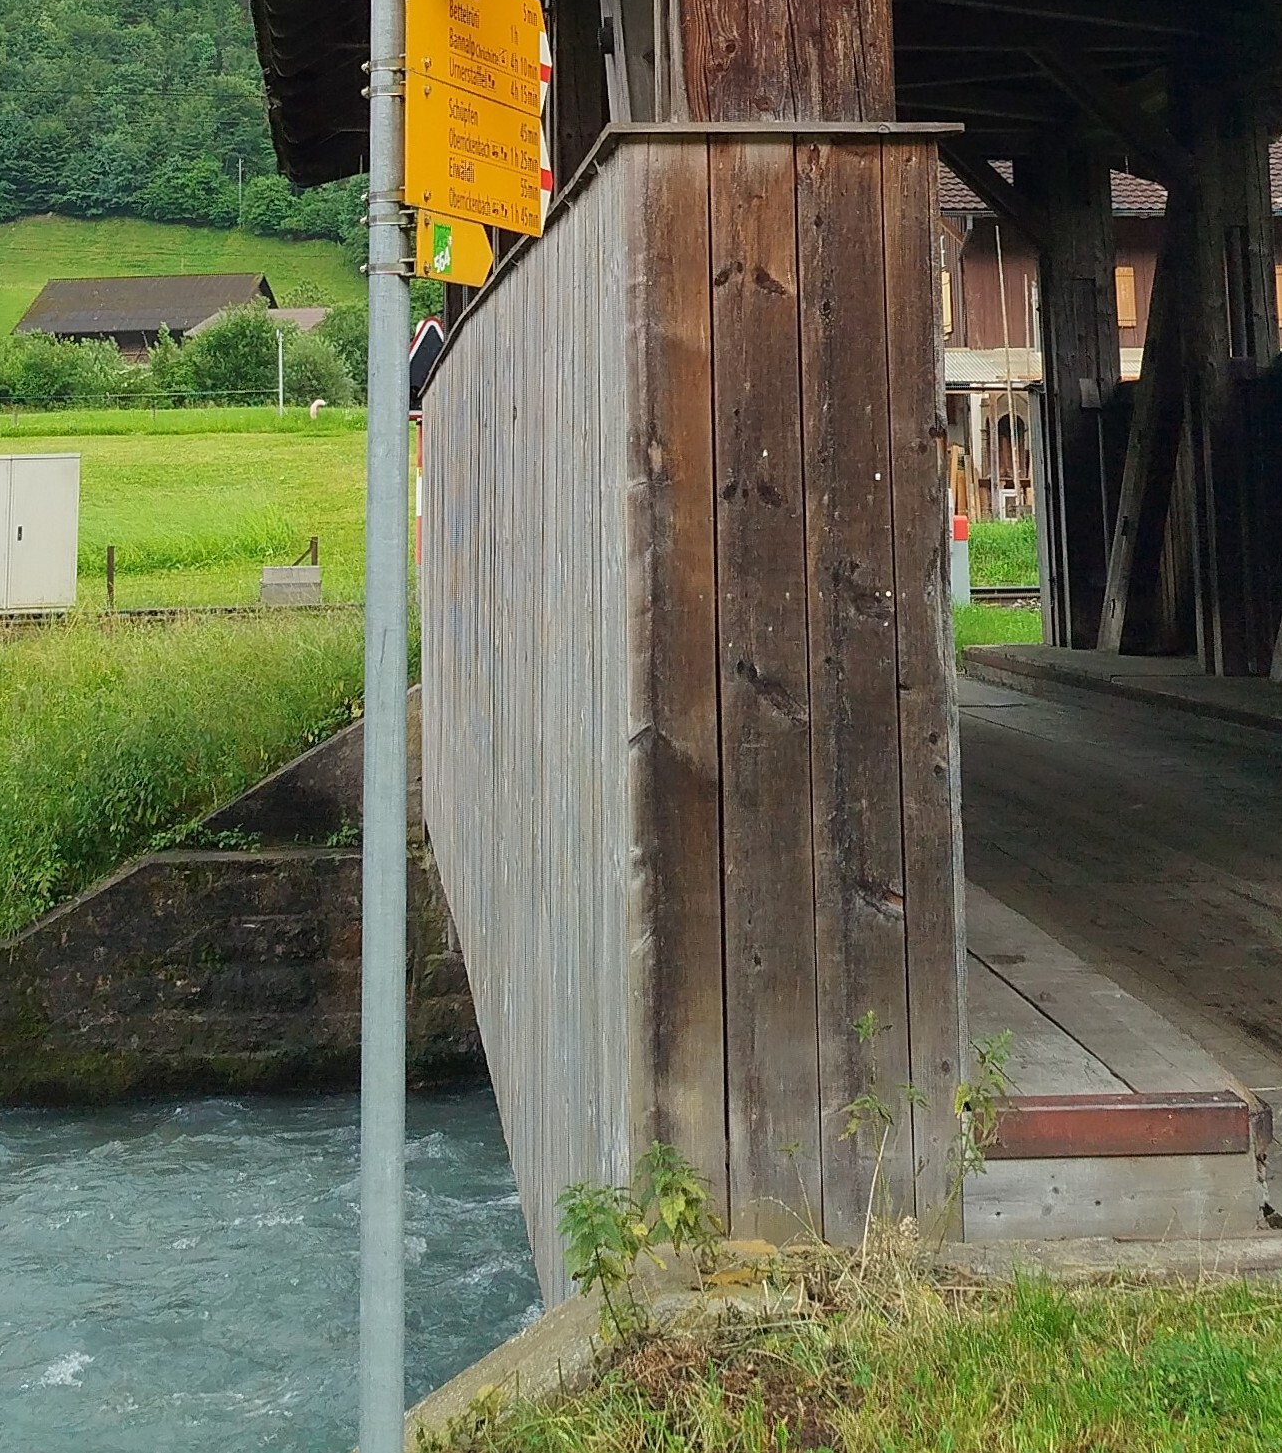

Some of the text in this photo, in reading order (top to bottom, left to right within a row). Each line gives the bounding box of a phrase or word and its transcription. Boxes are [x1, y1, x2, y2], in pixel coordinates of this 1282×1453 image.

[448, 26, 476, 61] Bannalp
[448, 97, 479, 127] Schüpfen
[433, 246, 451, 273] 564
